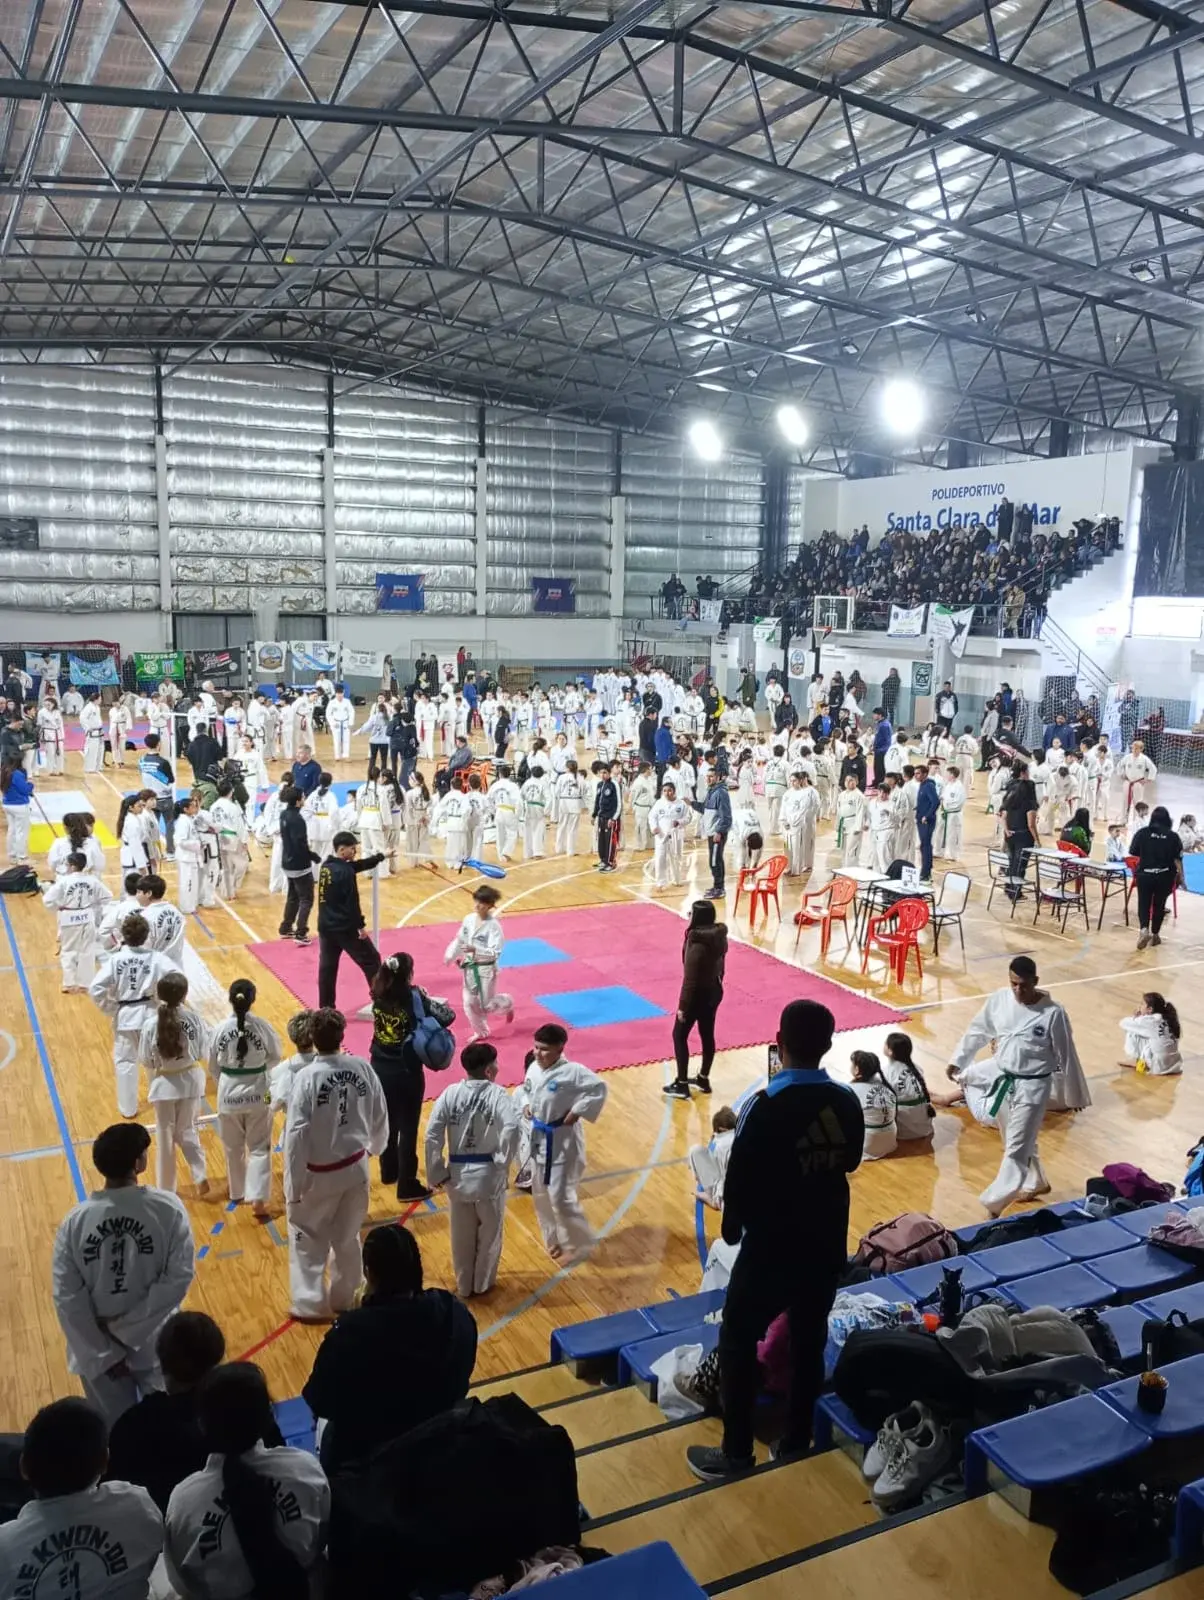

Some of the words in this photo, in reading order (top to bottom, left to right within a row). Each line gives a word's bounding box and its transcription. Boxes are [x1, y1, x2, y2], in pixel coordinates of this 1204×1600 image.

[931, 483, 1005, 501] POLIDEPORTIVO
[887, 510, 931, 533] Santa
[937, 506, 980, 530] Clara
